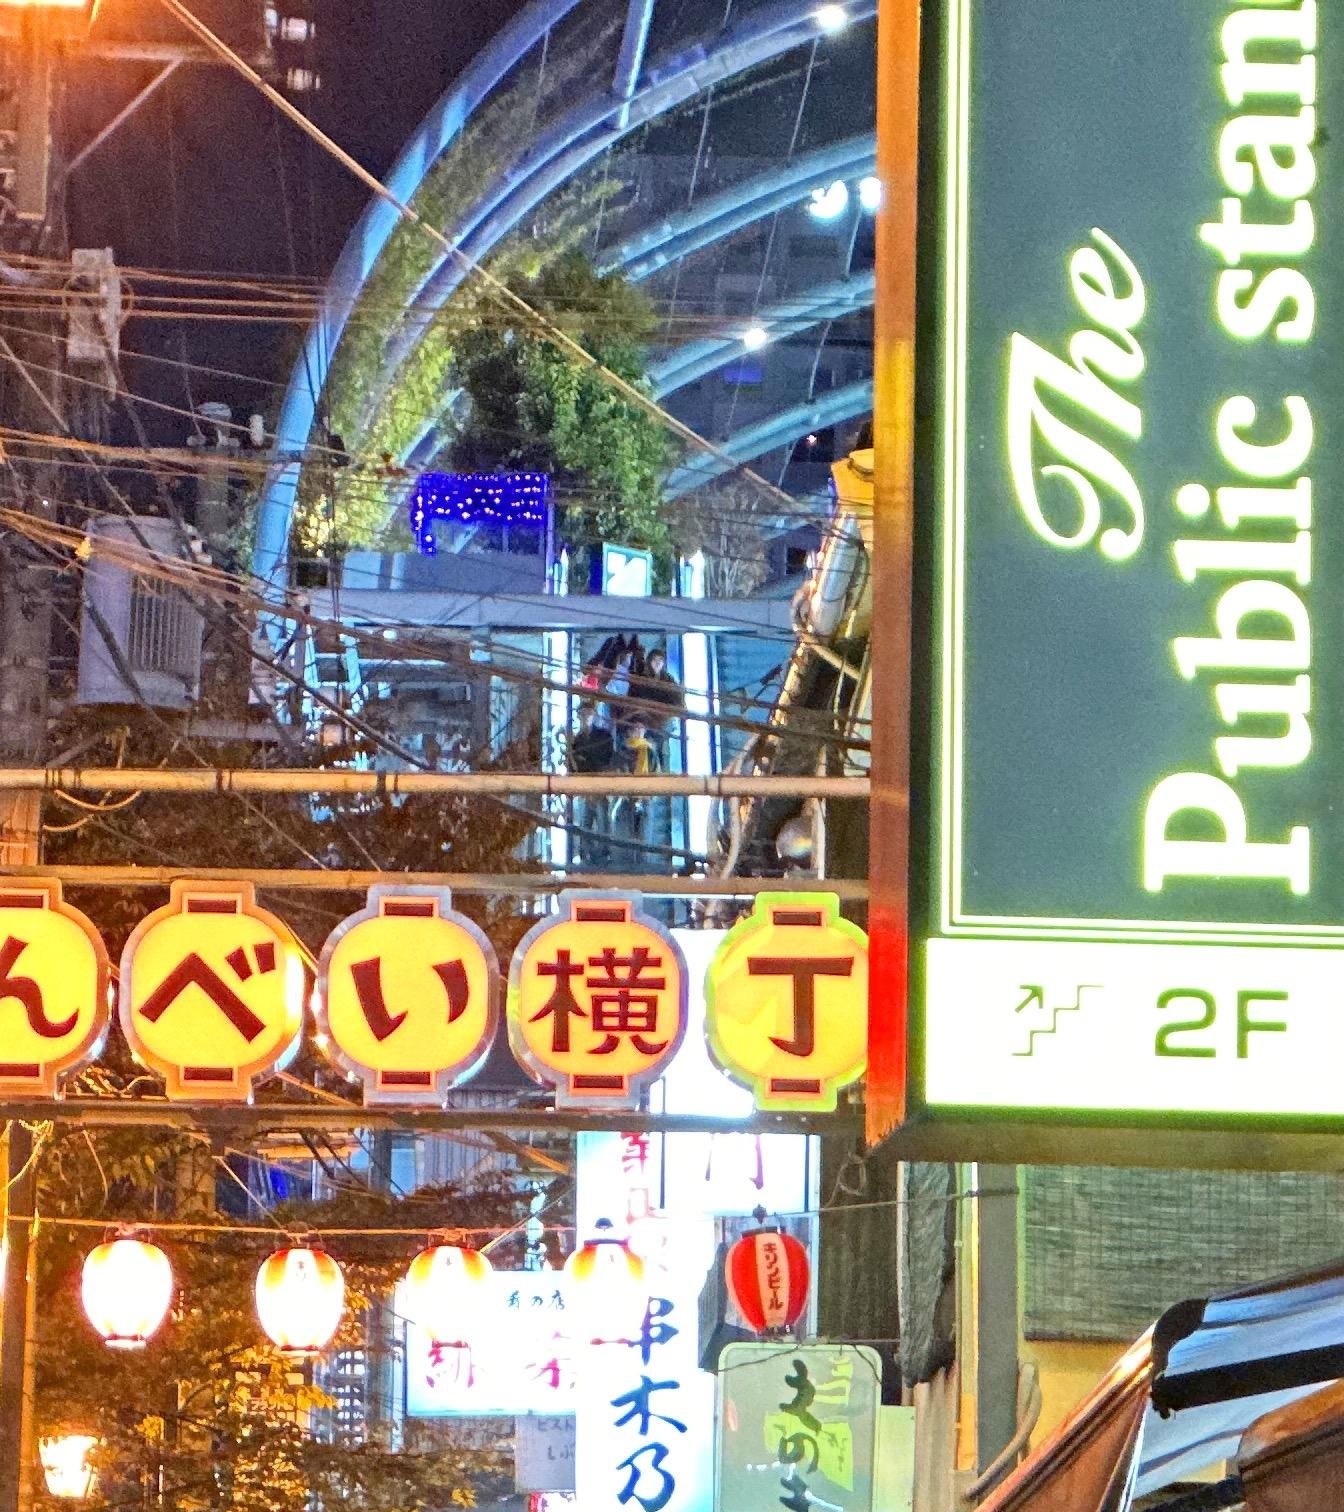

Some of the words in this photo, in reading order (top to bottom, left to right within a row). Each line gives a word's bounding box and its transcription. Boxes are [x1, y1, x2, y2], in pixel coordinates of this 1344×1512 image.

[1006, 227, 1148, 560] The
[1143, 395, 1315, 896] Public
[1154, 987, 1289, 1059] 2F
[762, 1243, 785, 1311] キリンビール
